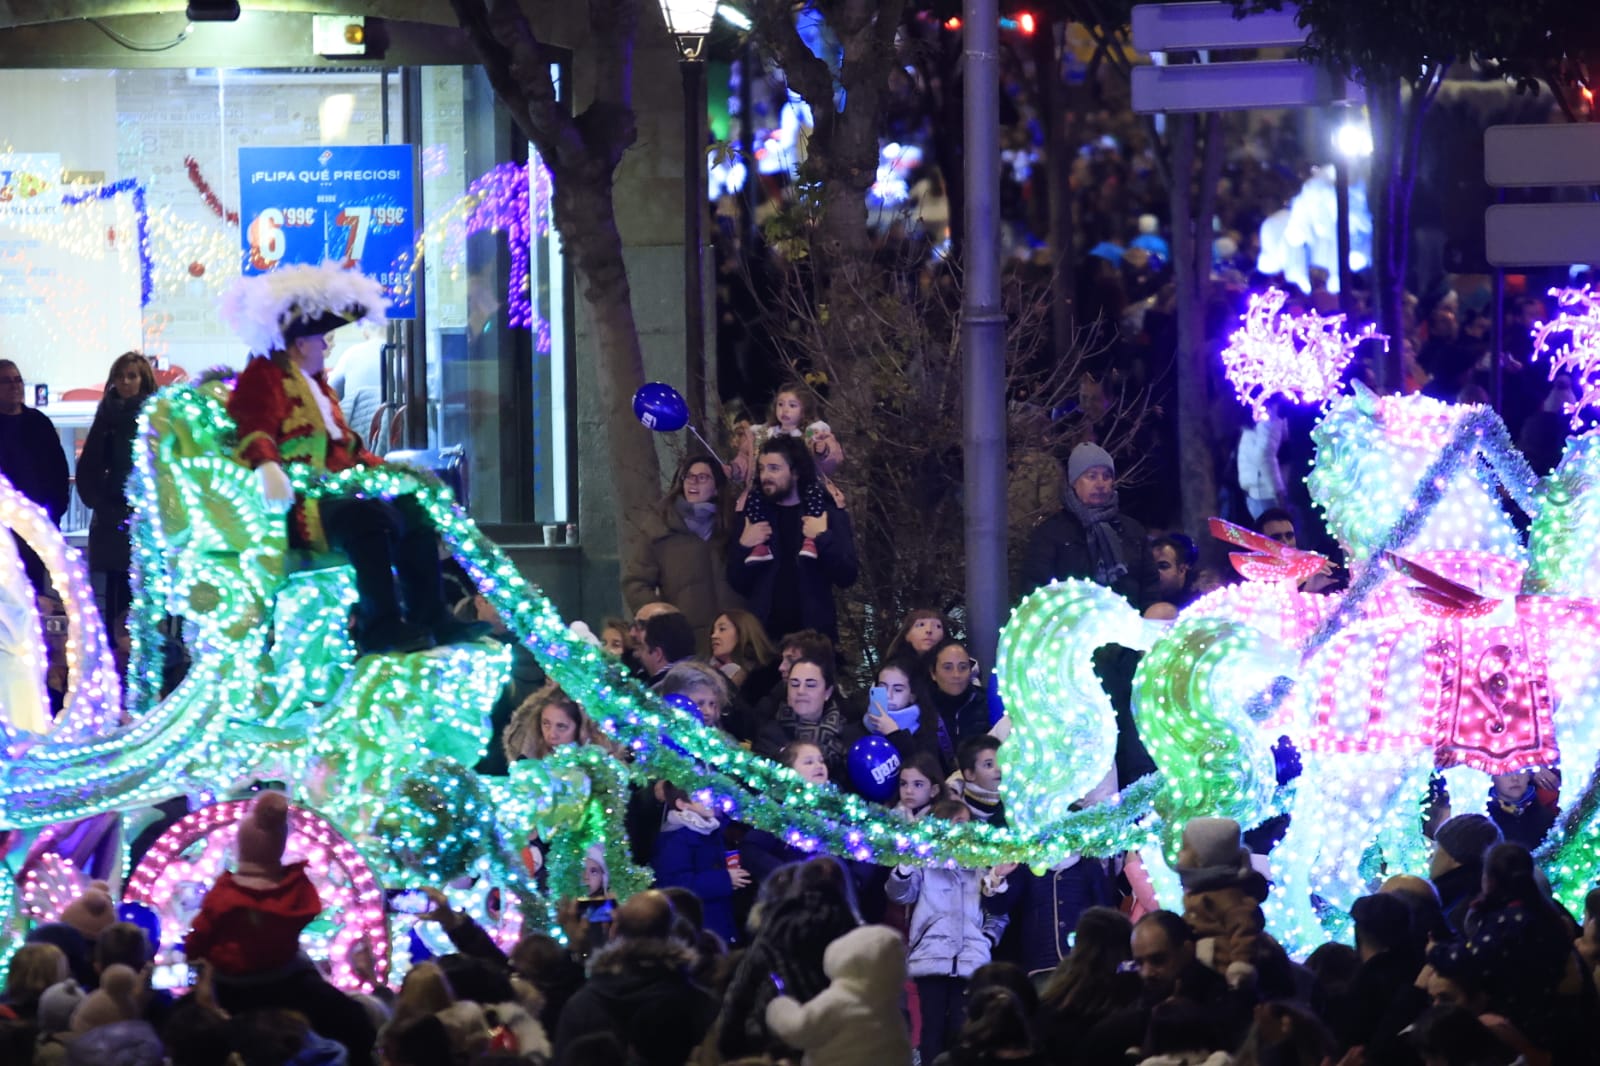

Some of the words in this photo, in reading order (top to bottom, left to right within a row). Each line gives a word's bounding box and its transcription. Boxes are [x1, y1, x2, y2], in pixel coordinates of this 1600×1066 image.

[251, 170, 296, 184] ¡FLIPA
[299, 168, 330, 183] QUÉ
[333, 170, 401, 181] PRECIOS!
[870, 753, 902, 785] gaza
